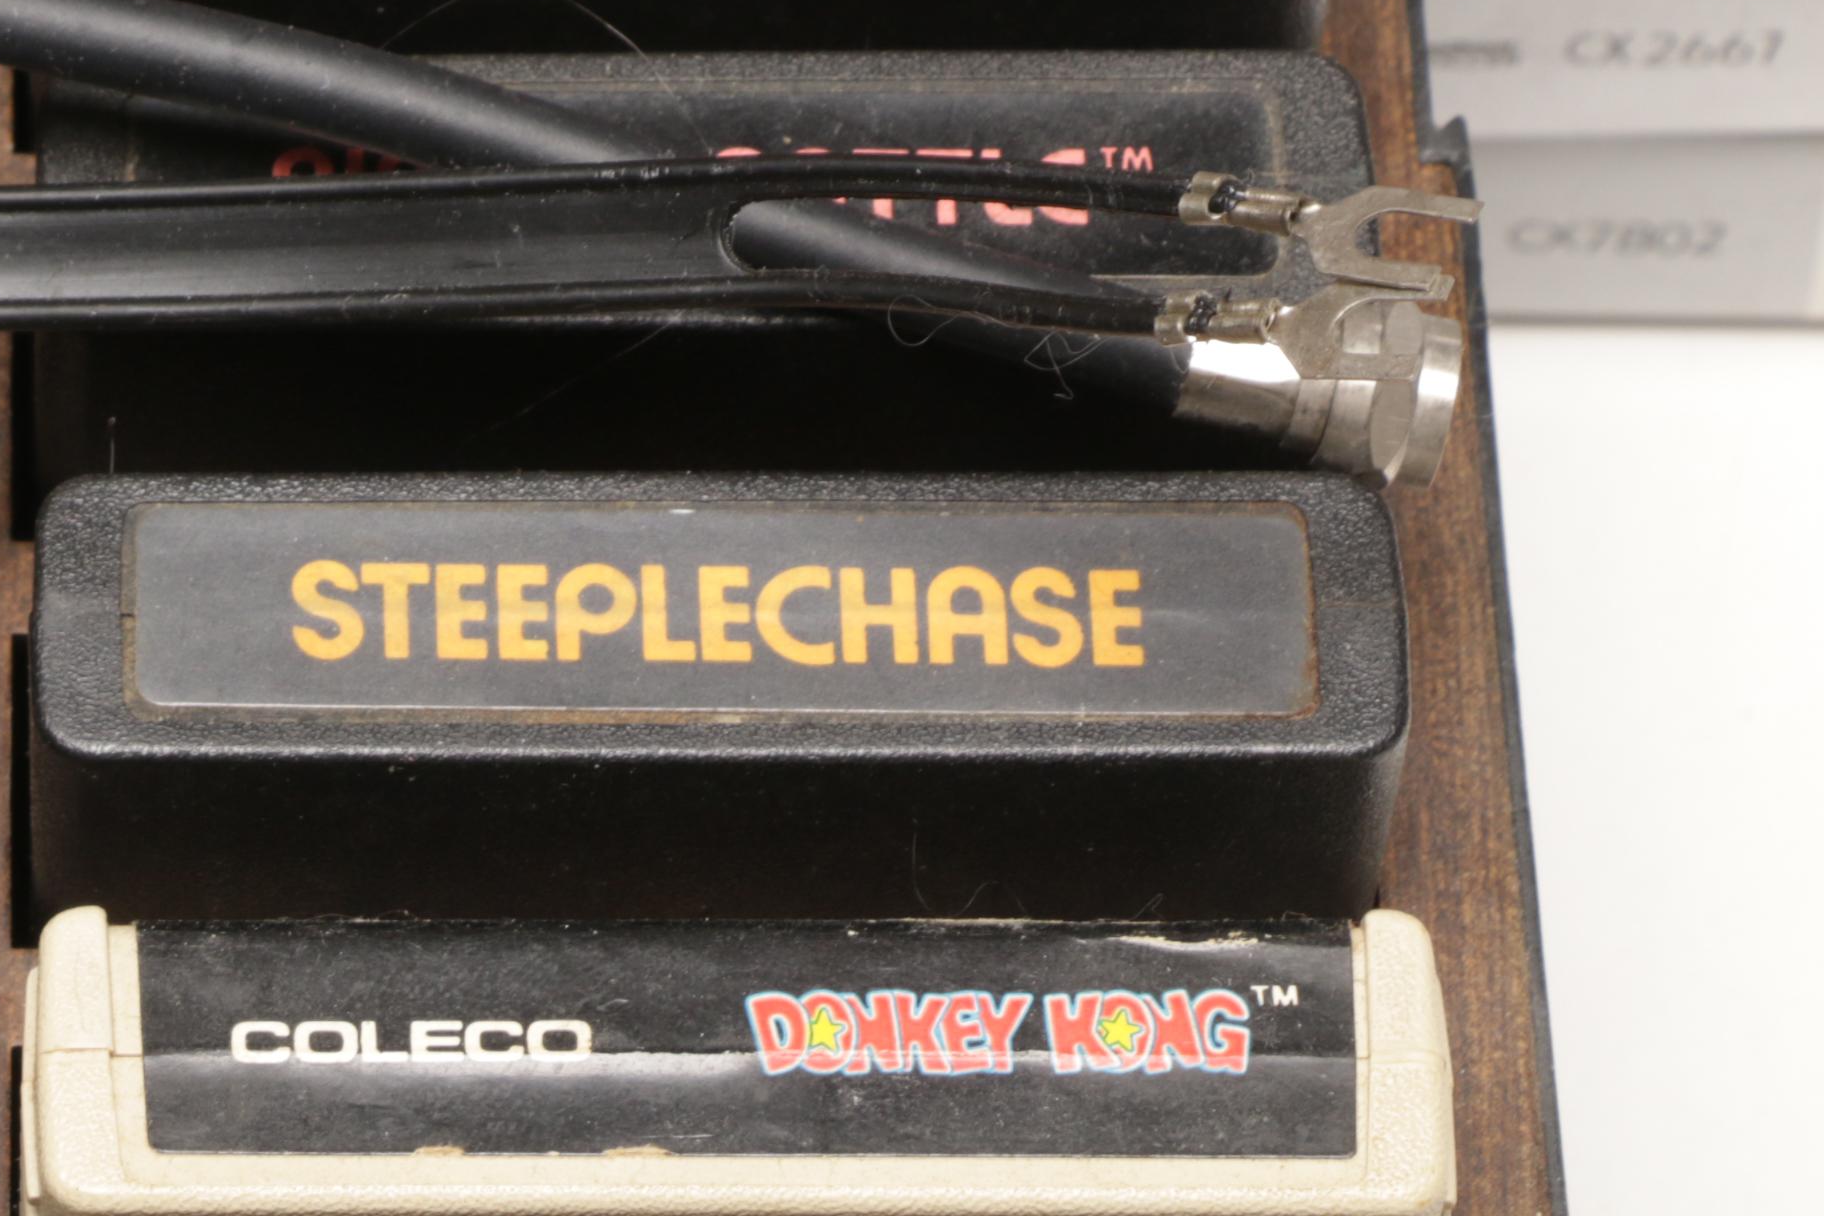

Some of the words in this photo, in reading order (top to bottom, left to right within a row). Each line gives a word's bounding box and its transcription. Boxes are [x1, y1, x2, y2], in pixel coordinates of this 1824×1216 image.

[289, 560, 1144, 668] STEEPLECHASE
[229, 1019, 593, 1065] COLECO
[744, 988, 1032, 1076] DONKEY
